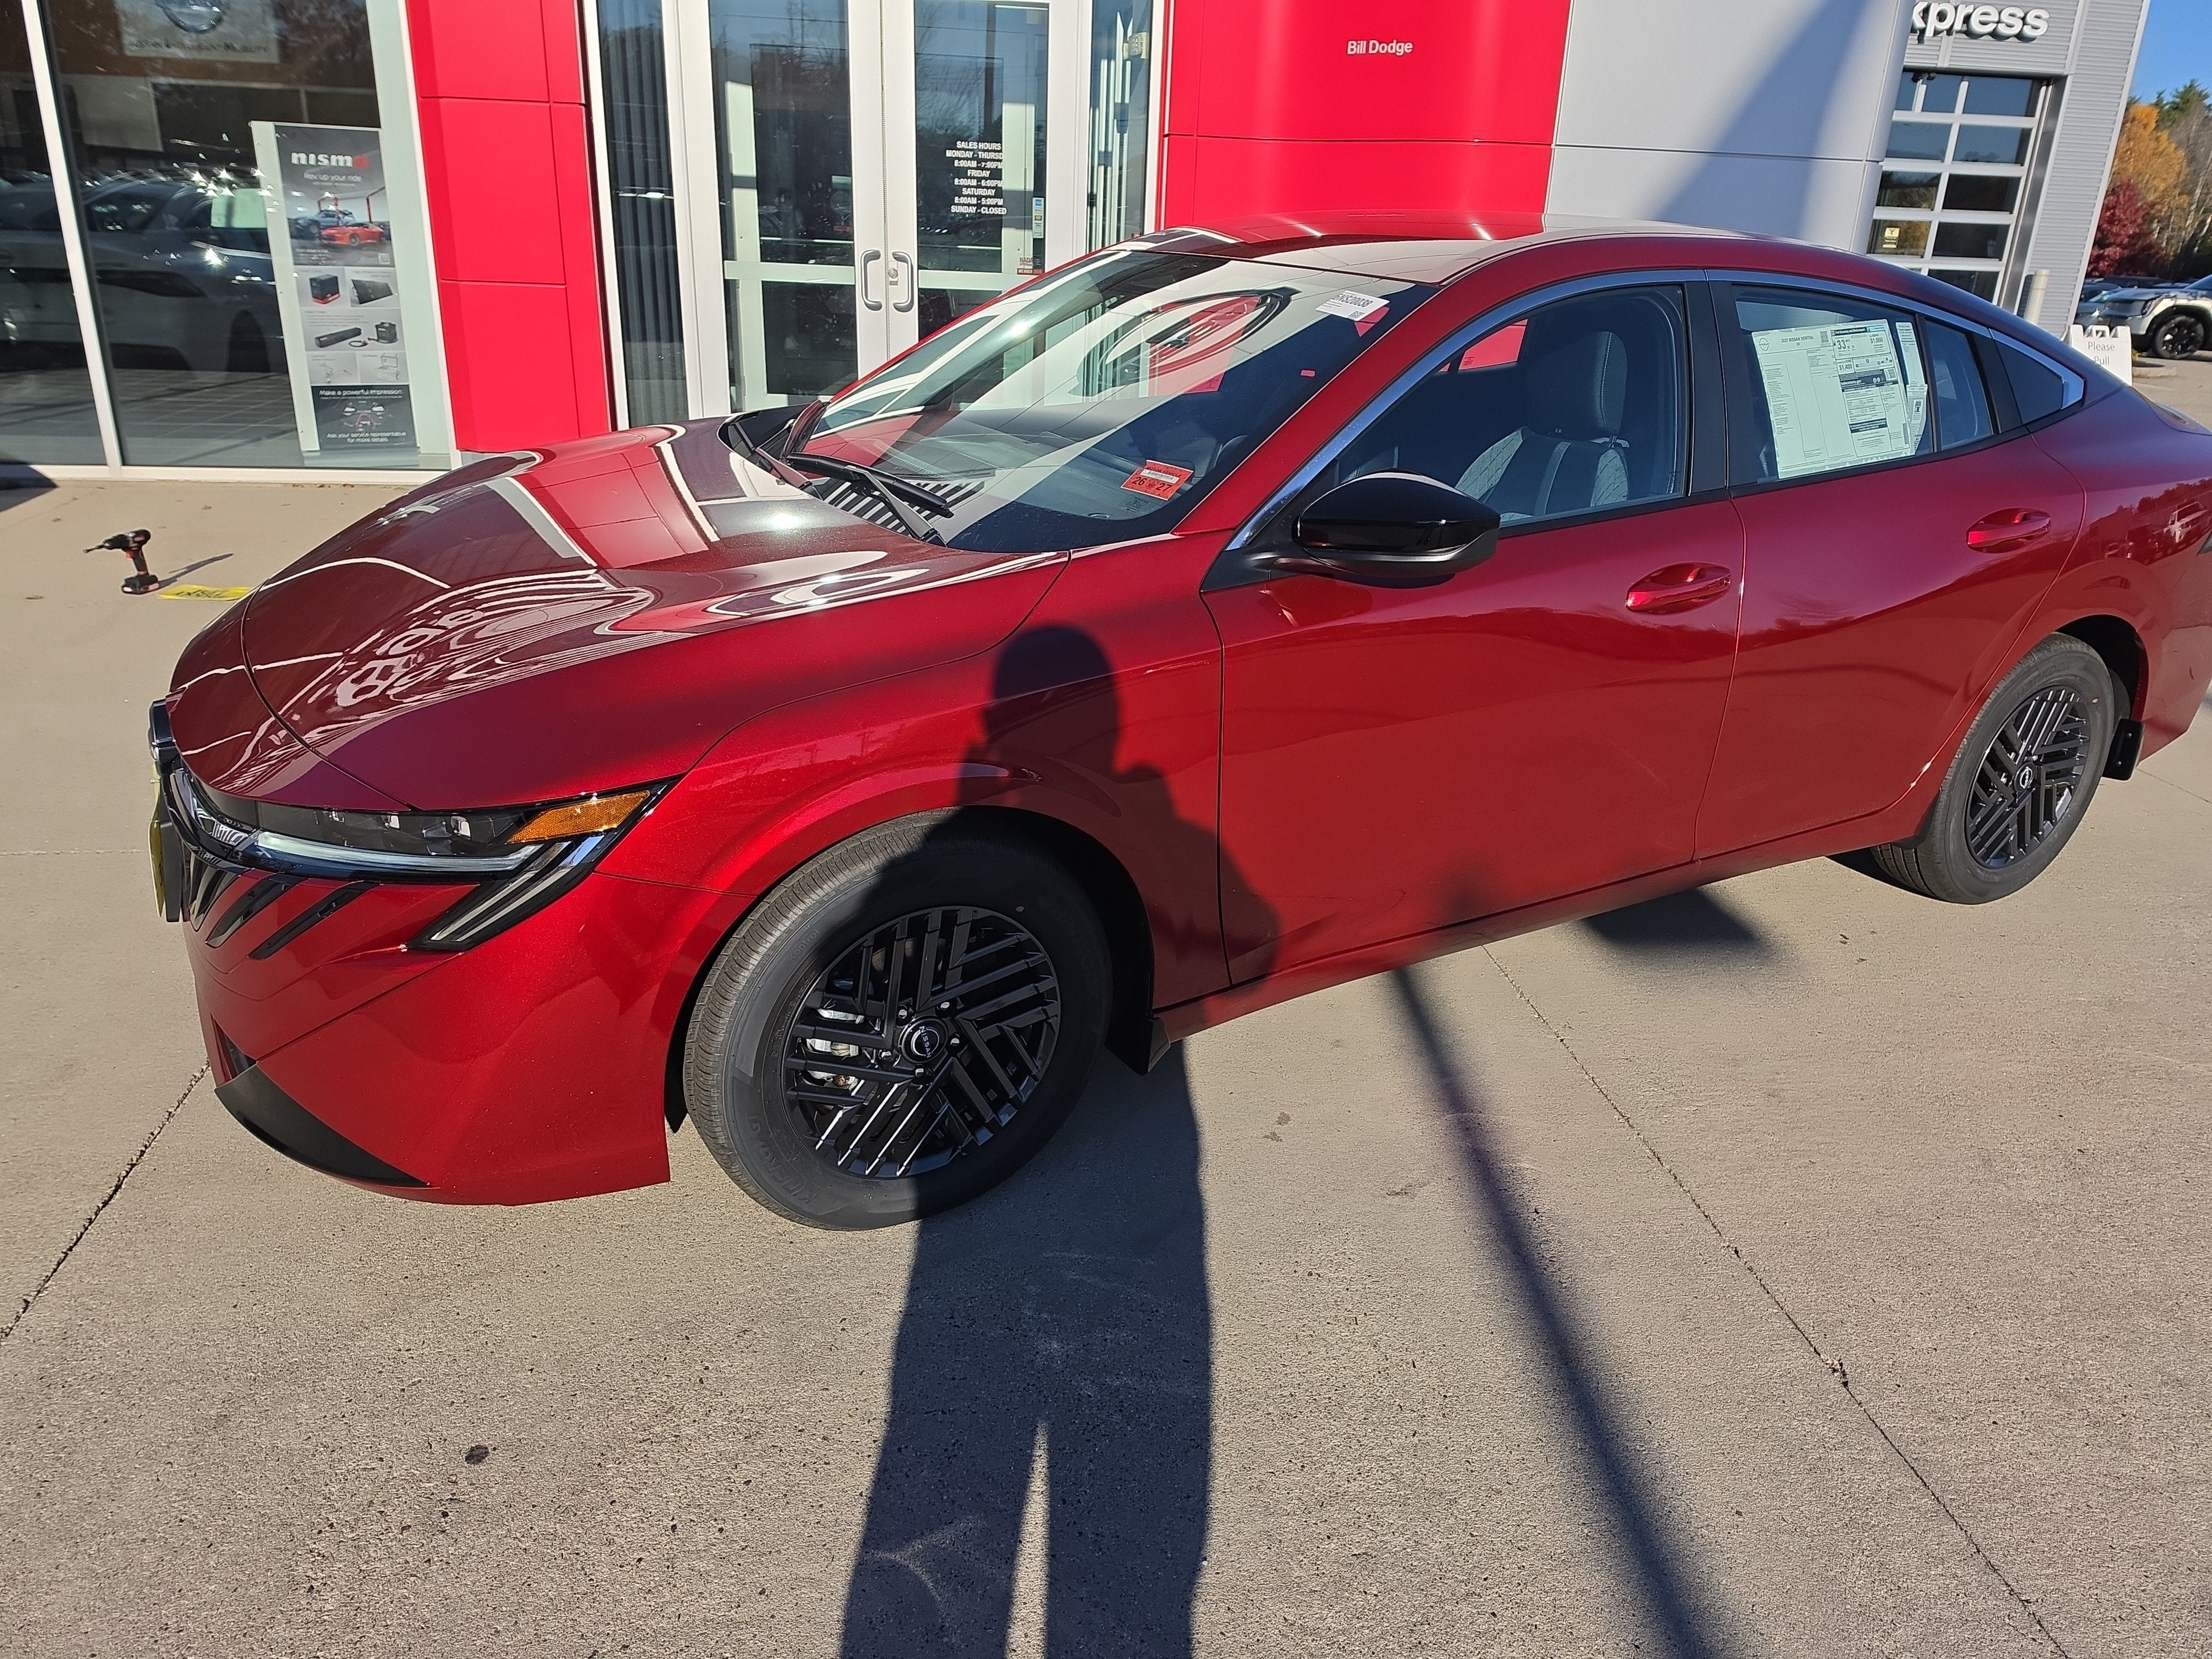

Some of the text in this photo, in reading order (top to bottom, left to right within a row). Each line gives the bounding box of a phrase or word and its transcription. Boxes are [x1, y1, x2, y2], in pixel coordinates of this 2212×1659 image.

[1347, 39, 1413, 56] Bill Dodge
[956, 140, 1001, 150] SALES HOURS
[946, 150, 974, 158] MONDAY
[291, 152, 370, 168] nismo
[954, 159, 977, 168] 8:00AM
[967, 169, 991, 177] FRIDAY
[954, 178, 977, 186] 8:00AM
[962, 188, 996, 196] SATURDAY
[954, 196, 977, 204] 8:00AM
[951, 205, 976, 214] SUNDAY
[981, 207, 1007, 215] CLOSED
[1837, 339, 1846, 350] 33
[2088, 341, 2115, 351] Please
[1132, 477, 1173, 492] 26 27
[919, 1026, 931, 1058] NISSAN
